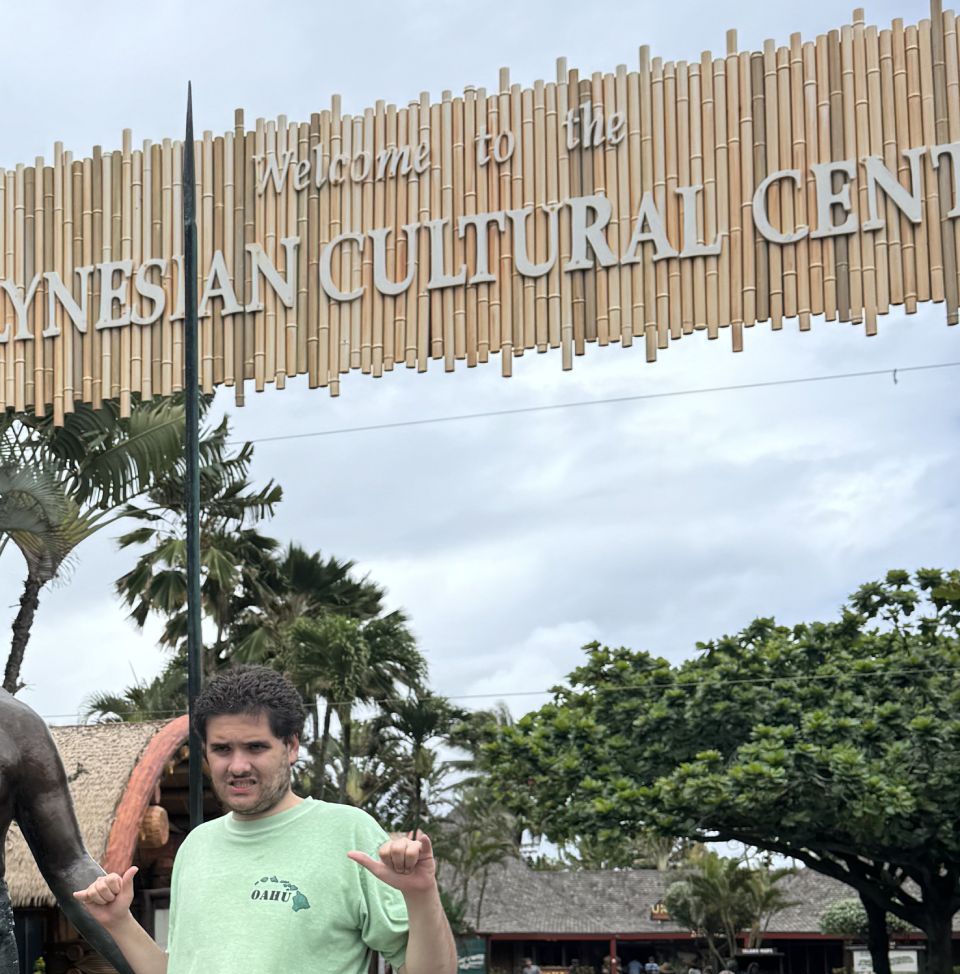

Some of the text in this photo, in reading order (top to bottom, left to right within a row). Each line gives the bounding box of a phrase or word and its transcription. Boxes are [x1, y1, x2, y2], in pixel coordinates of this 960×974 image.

[253, 101, 626, 196] Welcome to the
[320, 183, 724, 301] CULTURAL
[251, 890, 292, 903] OAHU
